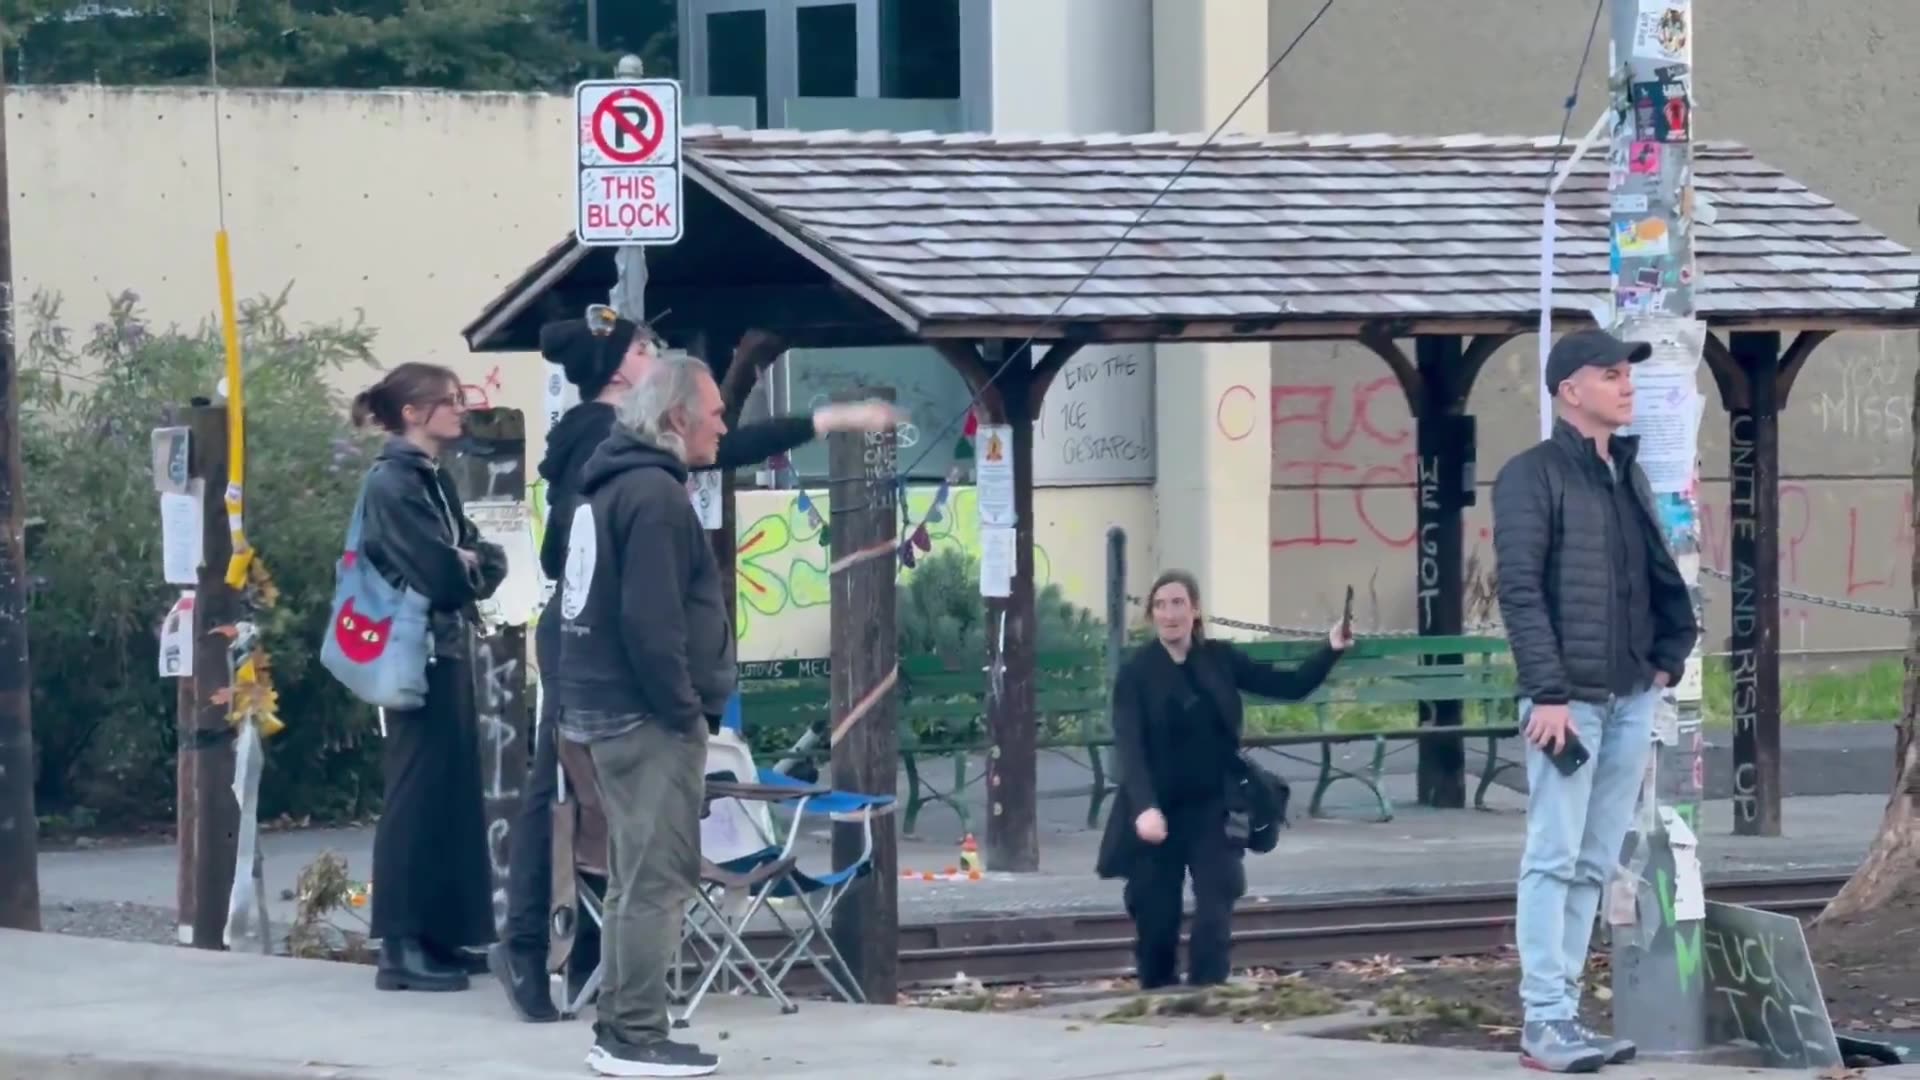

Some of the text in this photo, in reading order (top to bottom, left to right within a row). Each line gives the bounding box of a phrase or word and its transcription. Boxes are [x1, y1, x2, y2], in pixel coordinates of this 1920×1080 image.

[601, 176, 655, 199] THIS
[588, 204, 670, 227] BLOCK
[1064, 354, 1138, 390] END THE
[1061, 401, 1087, 430] ICE
[1271, 376, 1409, 450] FUC
[1820, 390, 1912, 436] MISS
[1271, 461, 1418, 547] IC
[1419, 455, 1440, 509] WE
[1419, 522, 1440, 630] GOT
[1731, 415, 1758, 822] UNITE AND RISE UP
[736, 659, 831, 678] LOTOVS MEL
[1704, 929, 1797, 1001] FUCK
[1714, 987, 1826, 1068] ICE
